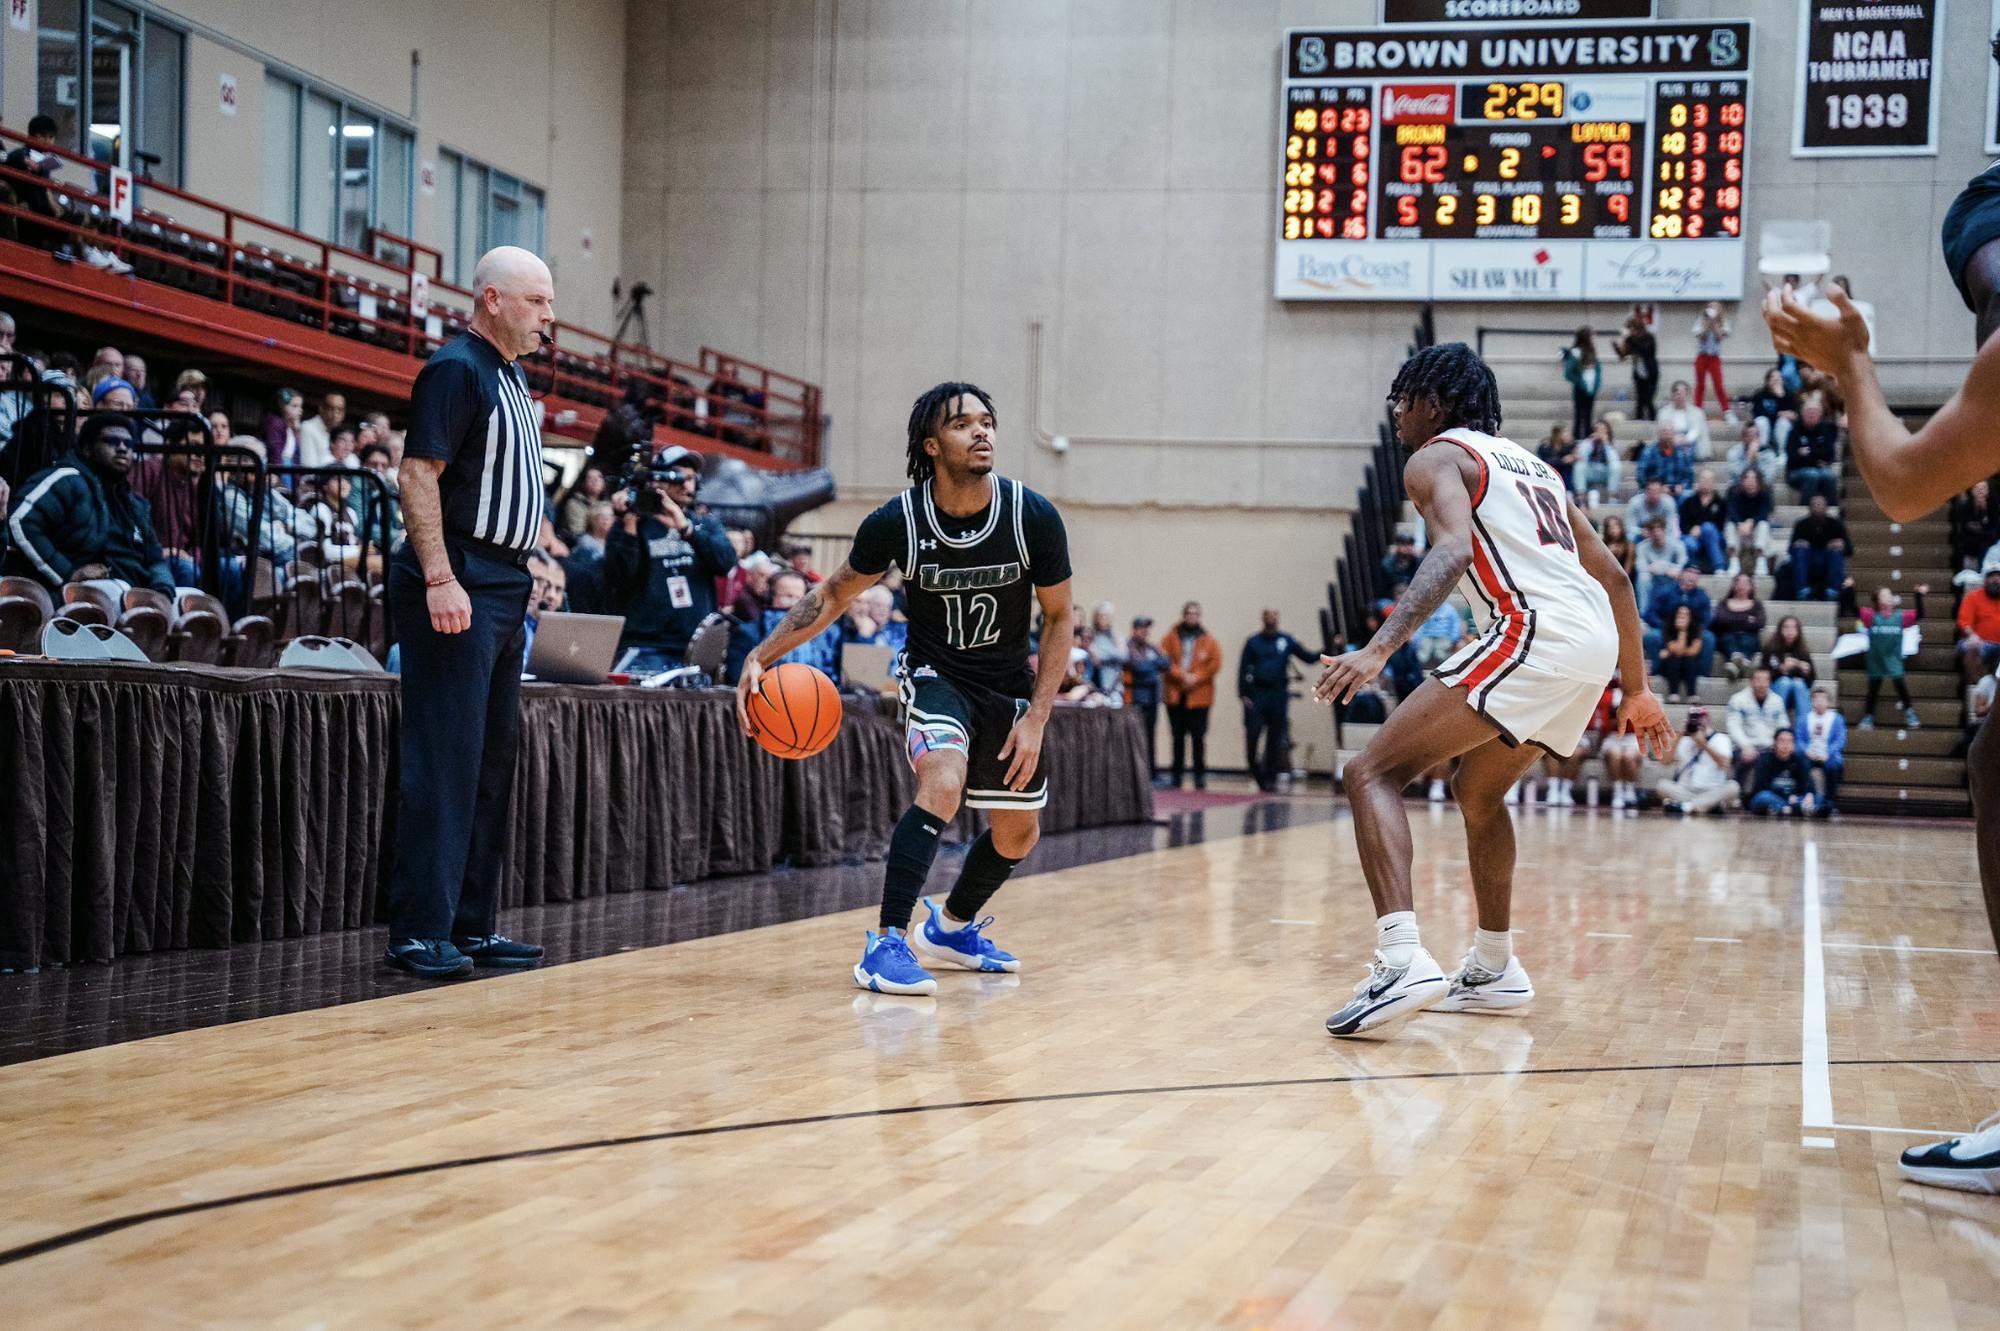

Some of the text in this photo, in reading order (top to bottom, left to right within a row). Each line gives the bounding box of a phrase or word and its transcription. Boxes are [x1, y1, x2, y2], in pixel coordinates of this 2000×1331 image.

[1445, 0, 1581, 17] SCOREBOARD
[1820, 4, 1924, 21] MEN'S BASKETBALL
[1334, 40, 1468, 69] BROWN
[1481, 34, 1699, 68] UNIVERSITY
[1833, 30, 1907, 59] NCAA
[1809, 59, 1930, 82] TOURNAMENT
[1484, 83, 1563, 120] 2:29
[1826, 93, 1908, 129] 1939
[1341, 107, 1371, 133] 23
[1670, 102, 1744, 128] 0 3 10
[1396, 124, 1446, 145] BROWN
[1571, 122, 1631, 143] LOYOLA
[1661, 131, 1743, 156] 10 3 10
[1286, 135, 1369, 160] 21 1 6
[1285, 161, 1369, 187] 22 4 6
[1400, 145, 1448, 183] 62
[1499, 147, 1520, 178] 2
[1583, 143, 1632, 182] 59
[1660, 158, 1741, 183] 11 3 6
[115, 177, 128, 209] F
[1284, 188, 1368, 214] 23 2 2
[1659, 186, 1684, 211] 12
[1687, 186, 1705, 211] 2
[1397, 194, 1419, 226] 5
[1435, 194, 1457, 226] 2
[1475, 193, 1541, 225] 3 10
[1560, 194, 1580, 225] 3
[1607, 193, 1629, 223] 9
[1284, 215, 1314, 240] 31
[1317, 217, 1335, 238] 4
[1651, 213, 1740, 238] 20 2 4
[1297, 253, 1411, 282] BayCoast
[1450, 269, 1562, 290] SHAWMUT
[1491, 452, 1530, 476] LILLY
[1515, 480, 1575, 553] 10
[940, 593, 1000, 650] 12
